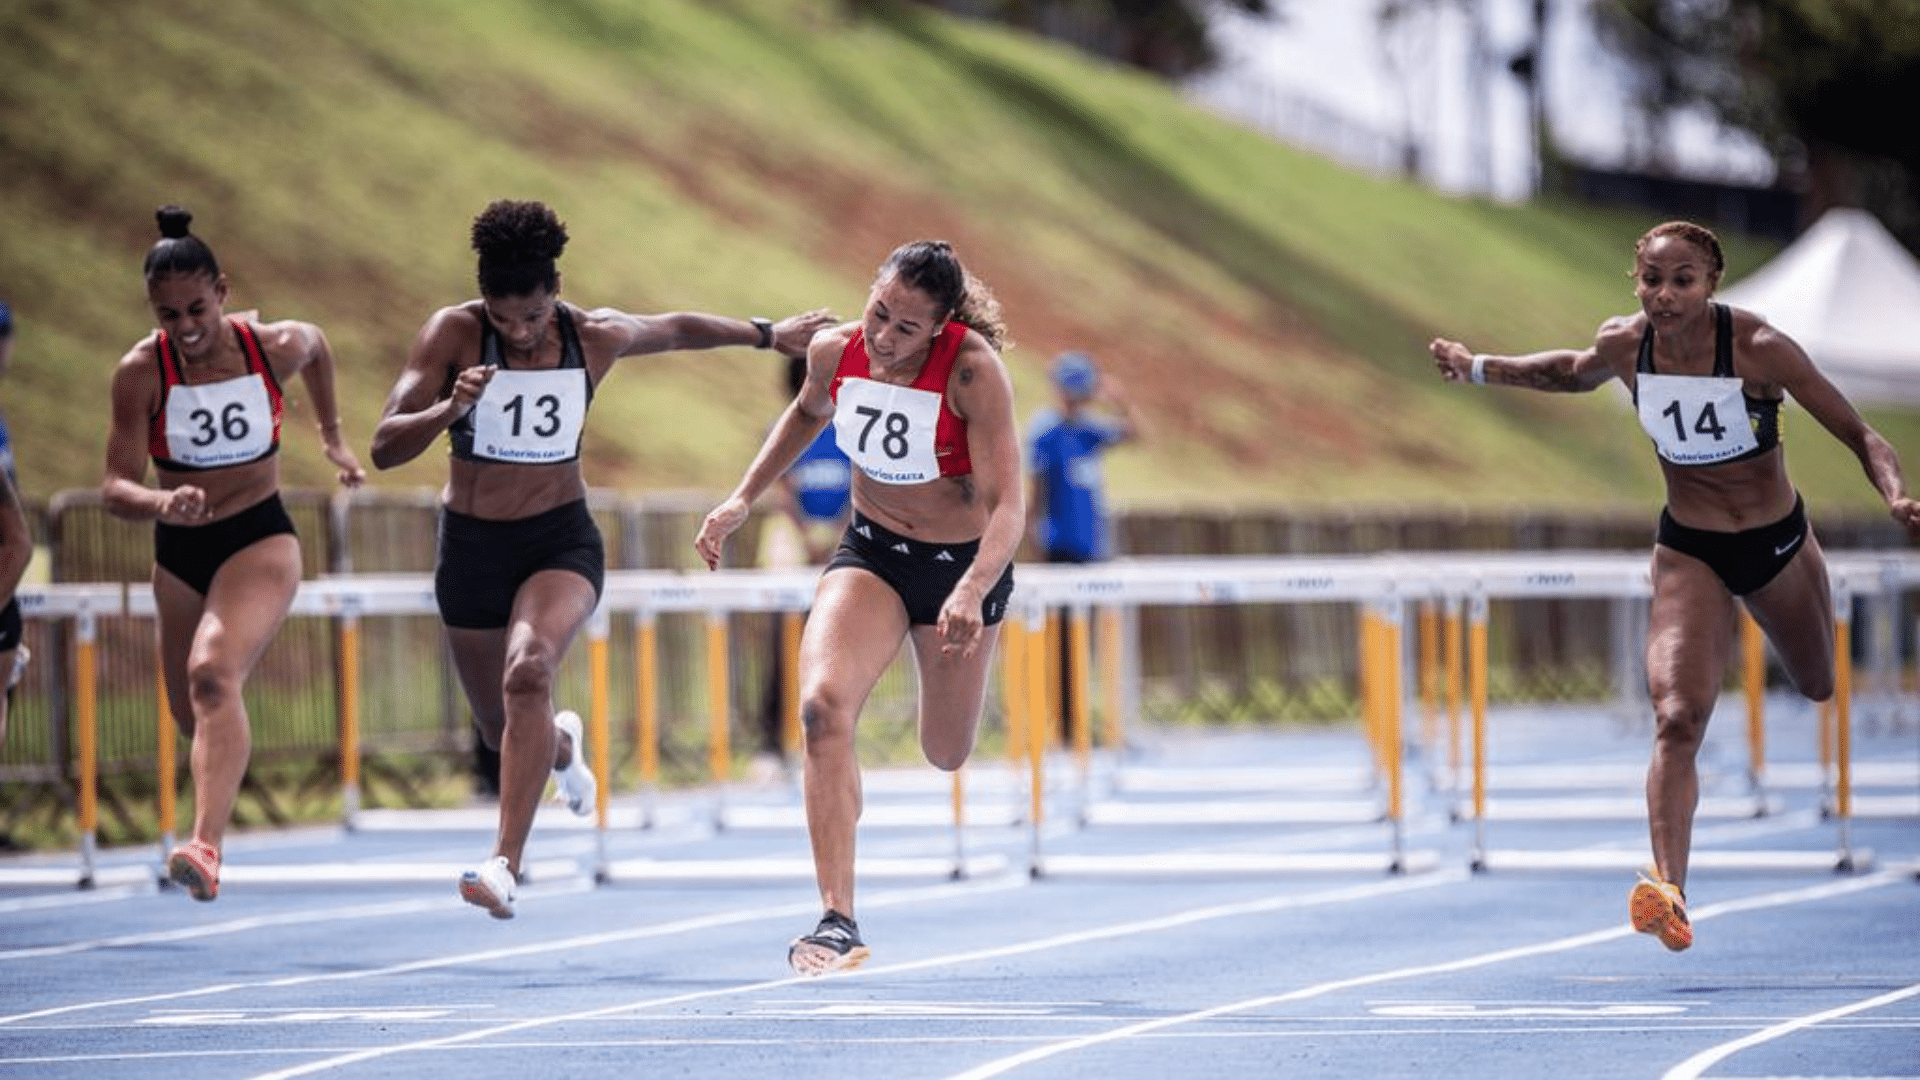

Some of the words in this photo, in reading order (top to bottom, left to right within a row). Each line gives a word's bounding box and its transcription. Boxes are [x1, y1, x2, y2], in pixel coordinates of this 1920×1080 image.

[189, 402, 249, 447] 36
[502, 394, 561, 438] 13
[855, 405, 910, 460] 78
[1662, 400, 1727, 442] 14
